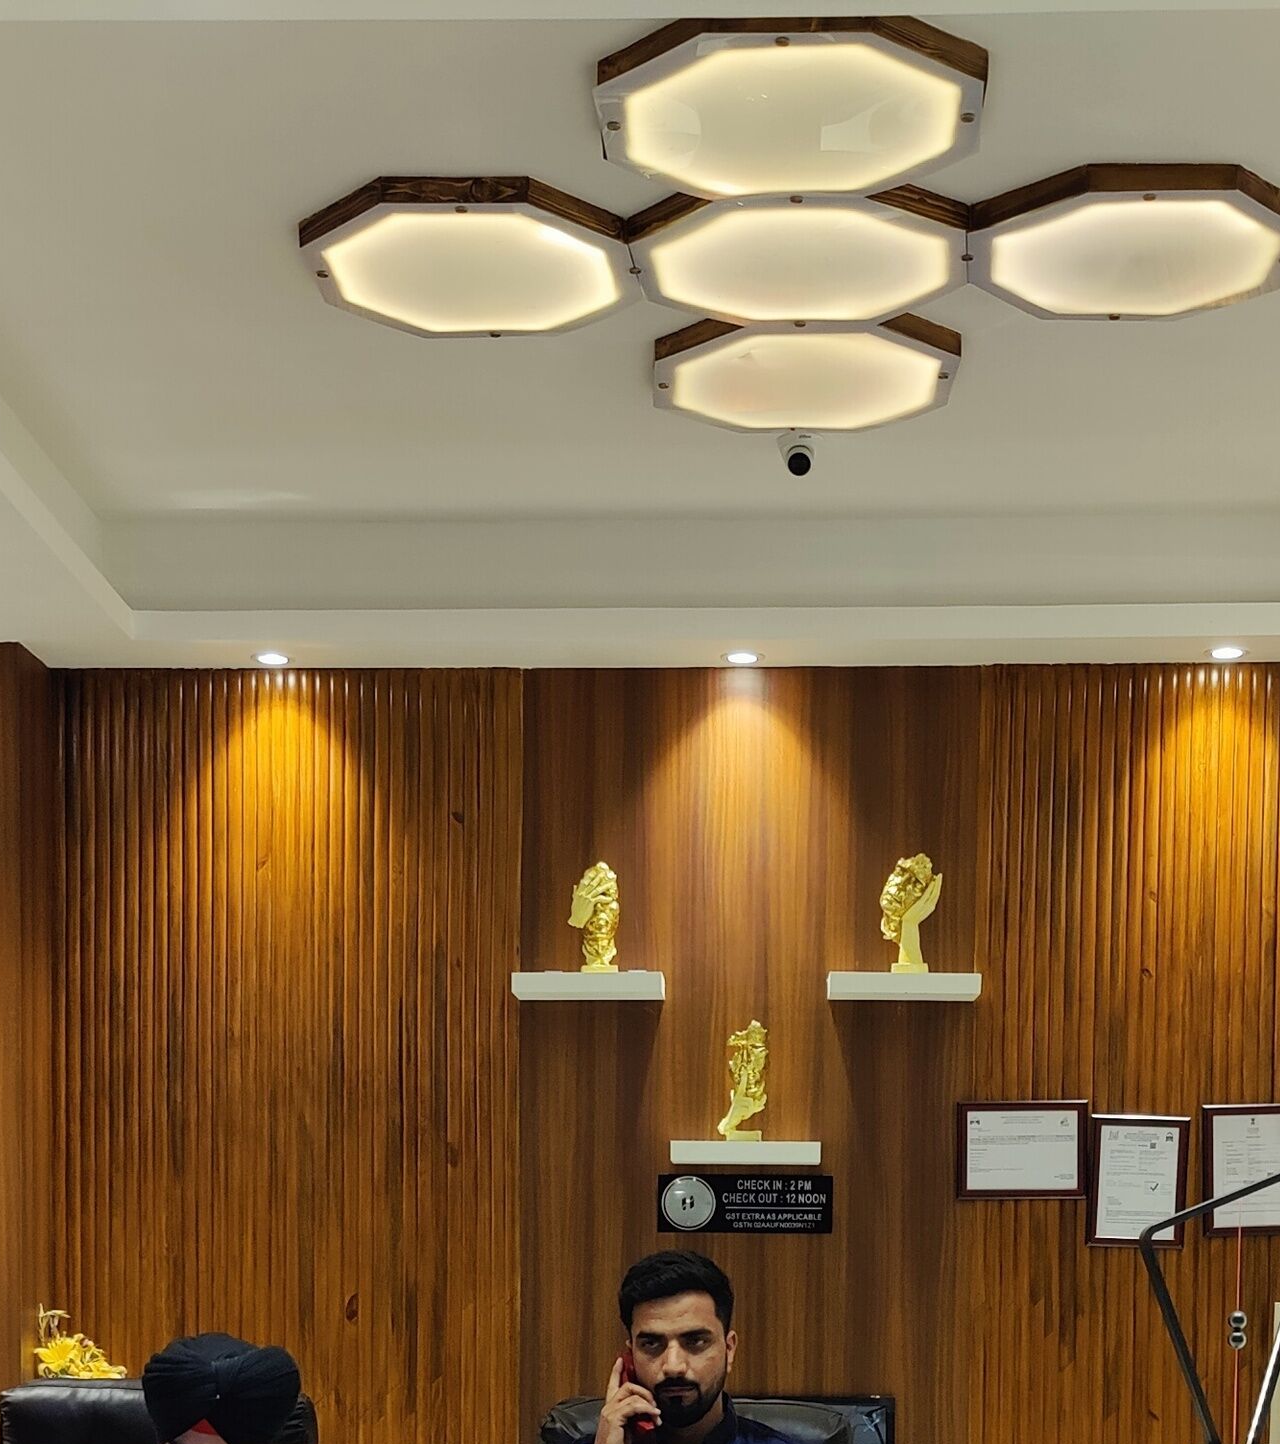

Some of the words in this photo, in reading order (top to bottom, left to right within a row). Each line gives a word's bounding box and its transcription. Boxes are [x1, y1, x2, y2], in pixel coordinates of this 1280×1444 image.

[737, 1179, 770, 1190] CHECK
[772, 1180, 783, 1190] IN
[790, 1180, 796, 1190] 2
[798, 1180, 812, 1190] PM
[722, 1192, 756, 1203] CHECK
[758, 1193, 778, 1203] OUT
[786, 1193, 796, 1203] 12
[798, 1193, 827, 1204] NOON
[725, 1212, 740, 1220] GST
[777, 1213, 822, 1221] APPLICABLE
